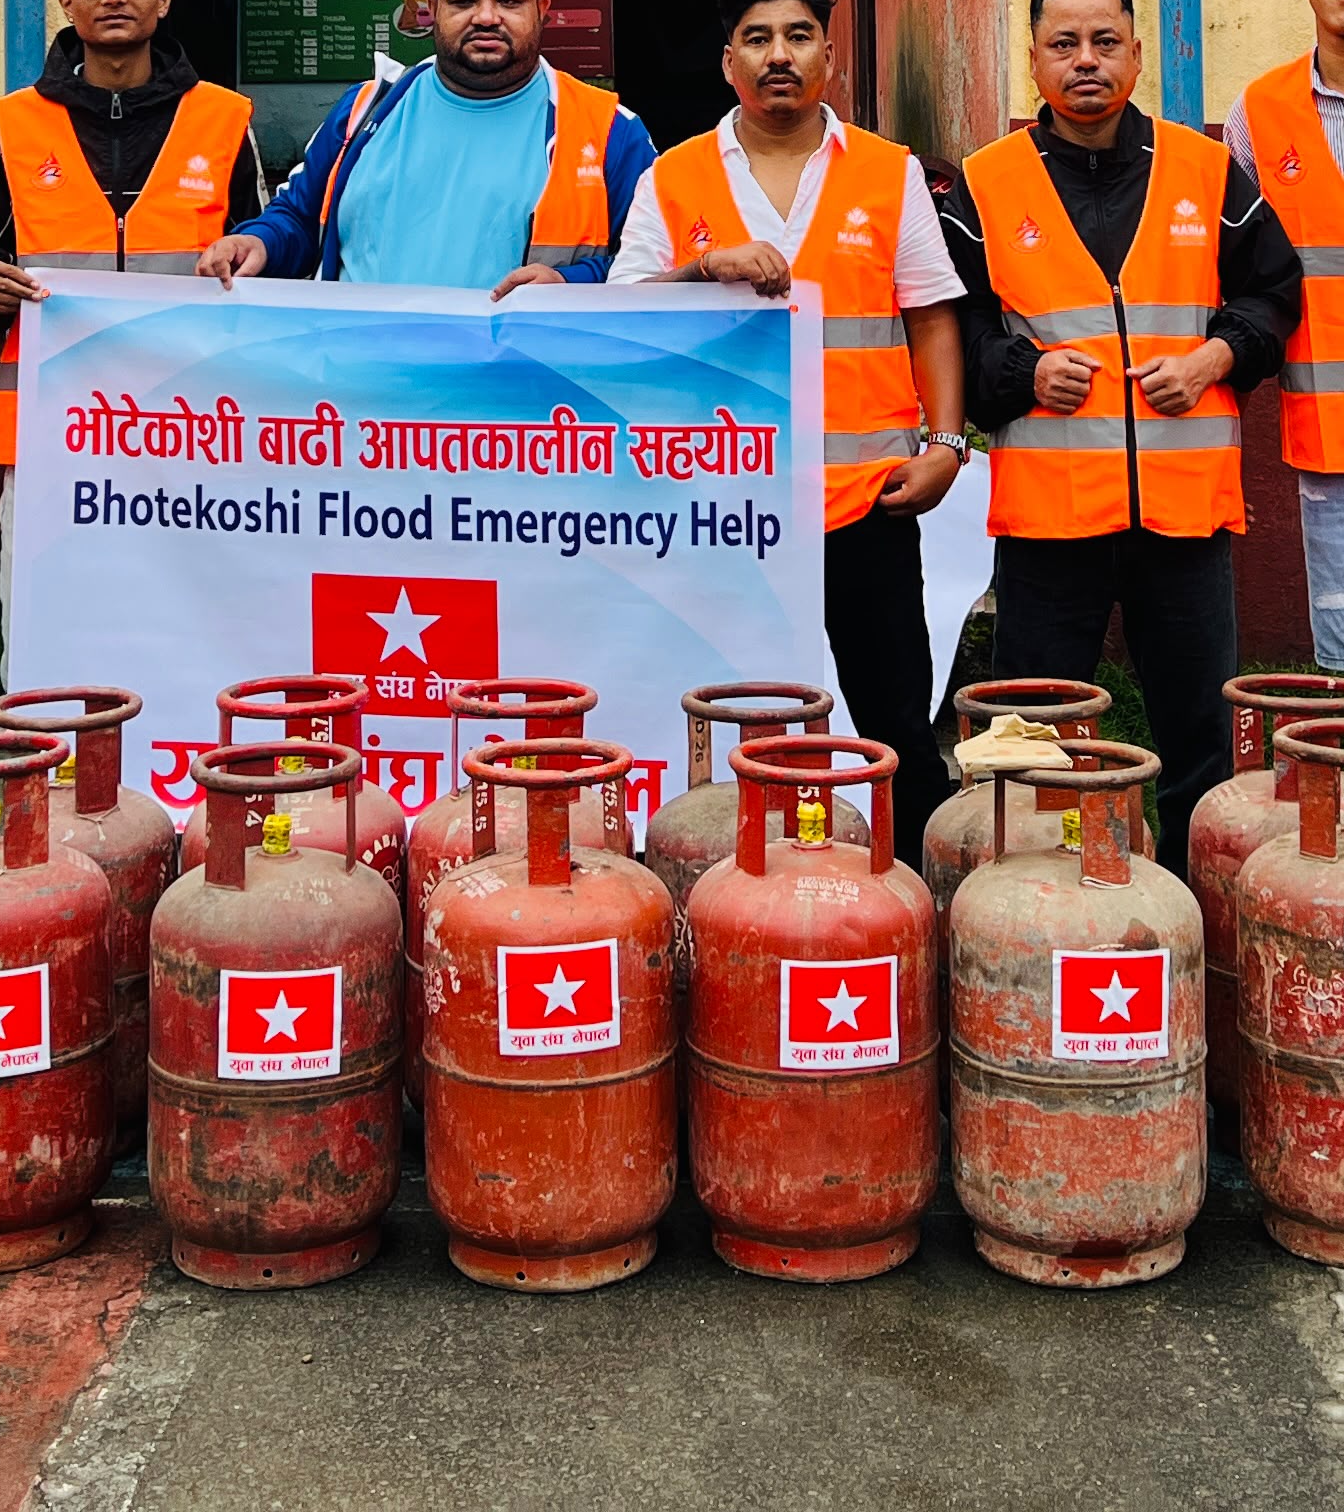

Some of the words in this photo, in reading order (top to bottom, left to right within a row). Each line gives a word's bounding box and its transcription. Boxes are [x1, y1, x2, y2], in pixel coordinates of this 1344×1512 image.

[1169, 224, 1206, 238] MARIA
[65, 390, 245, 465] भोटेकोशी
[258, 401, 345, 468] बाढी
[358, 403, 619, 479] आपतकालीन
[627, 406, 779, 481] सहयोग
[73, 480, 302, 535] Bhotekoshi
[318, 491, 433, 541] Flood
[451, 497, 678, 559] Emergency
[691, 500, 782, 559] Help
[375, 670, 416, 700] संघ
[474, 780, 489, 833] 15.5
[601, 780, 619, 832] 15.5
[362, 834, 398, 866] BABA
[510, 1034, 536, 1050] युवा
[541, 1032, 564, 1047] संघ
[572, 1027, 611, 1043] नेपाल
[1063, 1039, 1090, 1054] युवा
[1094, 1038, 1118, 1053] संघ
[1125, 1036, 1159, 1051] नेपाल
[0, 1051, 39, 1068] नेपाल
[229, 1059, 254, 1075] युवा
[259, 1059, 283, 1073] संघ
[290, 1055, 330, 1071] नेपाल
[791, 1048, 817, 1064] युवा
[821, 1047, 845, 1062] संघ
[852, 1044, 889, 1059] नेपाल
